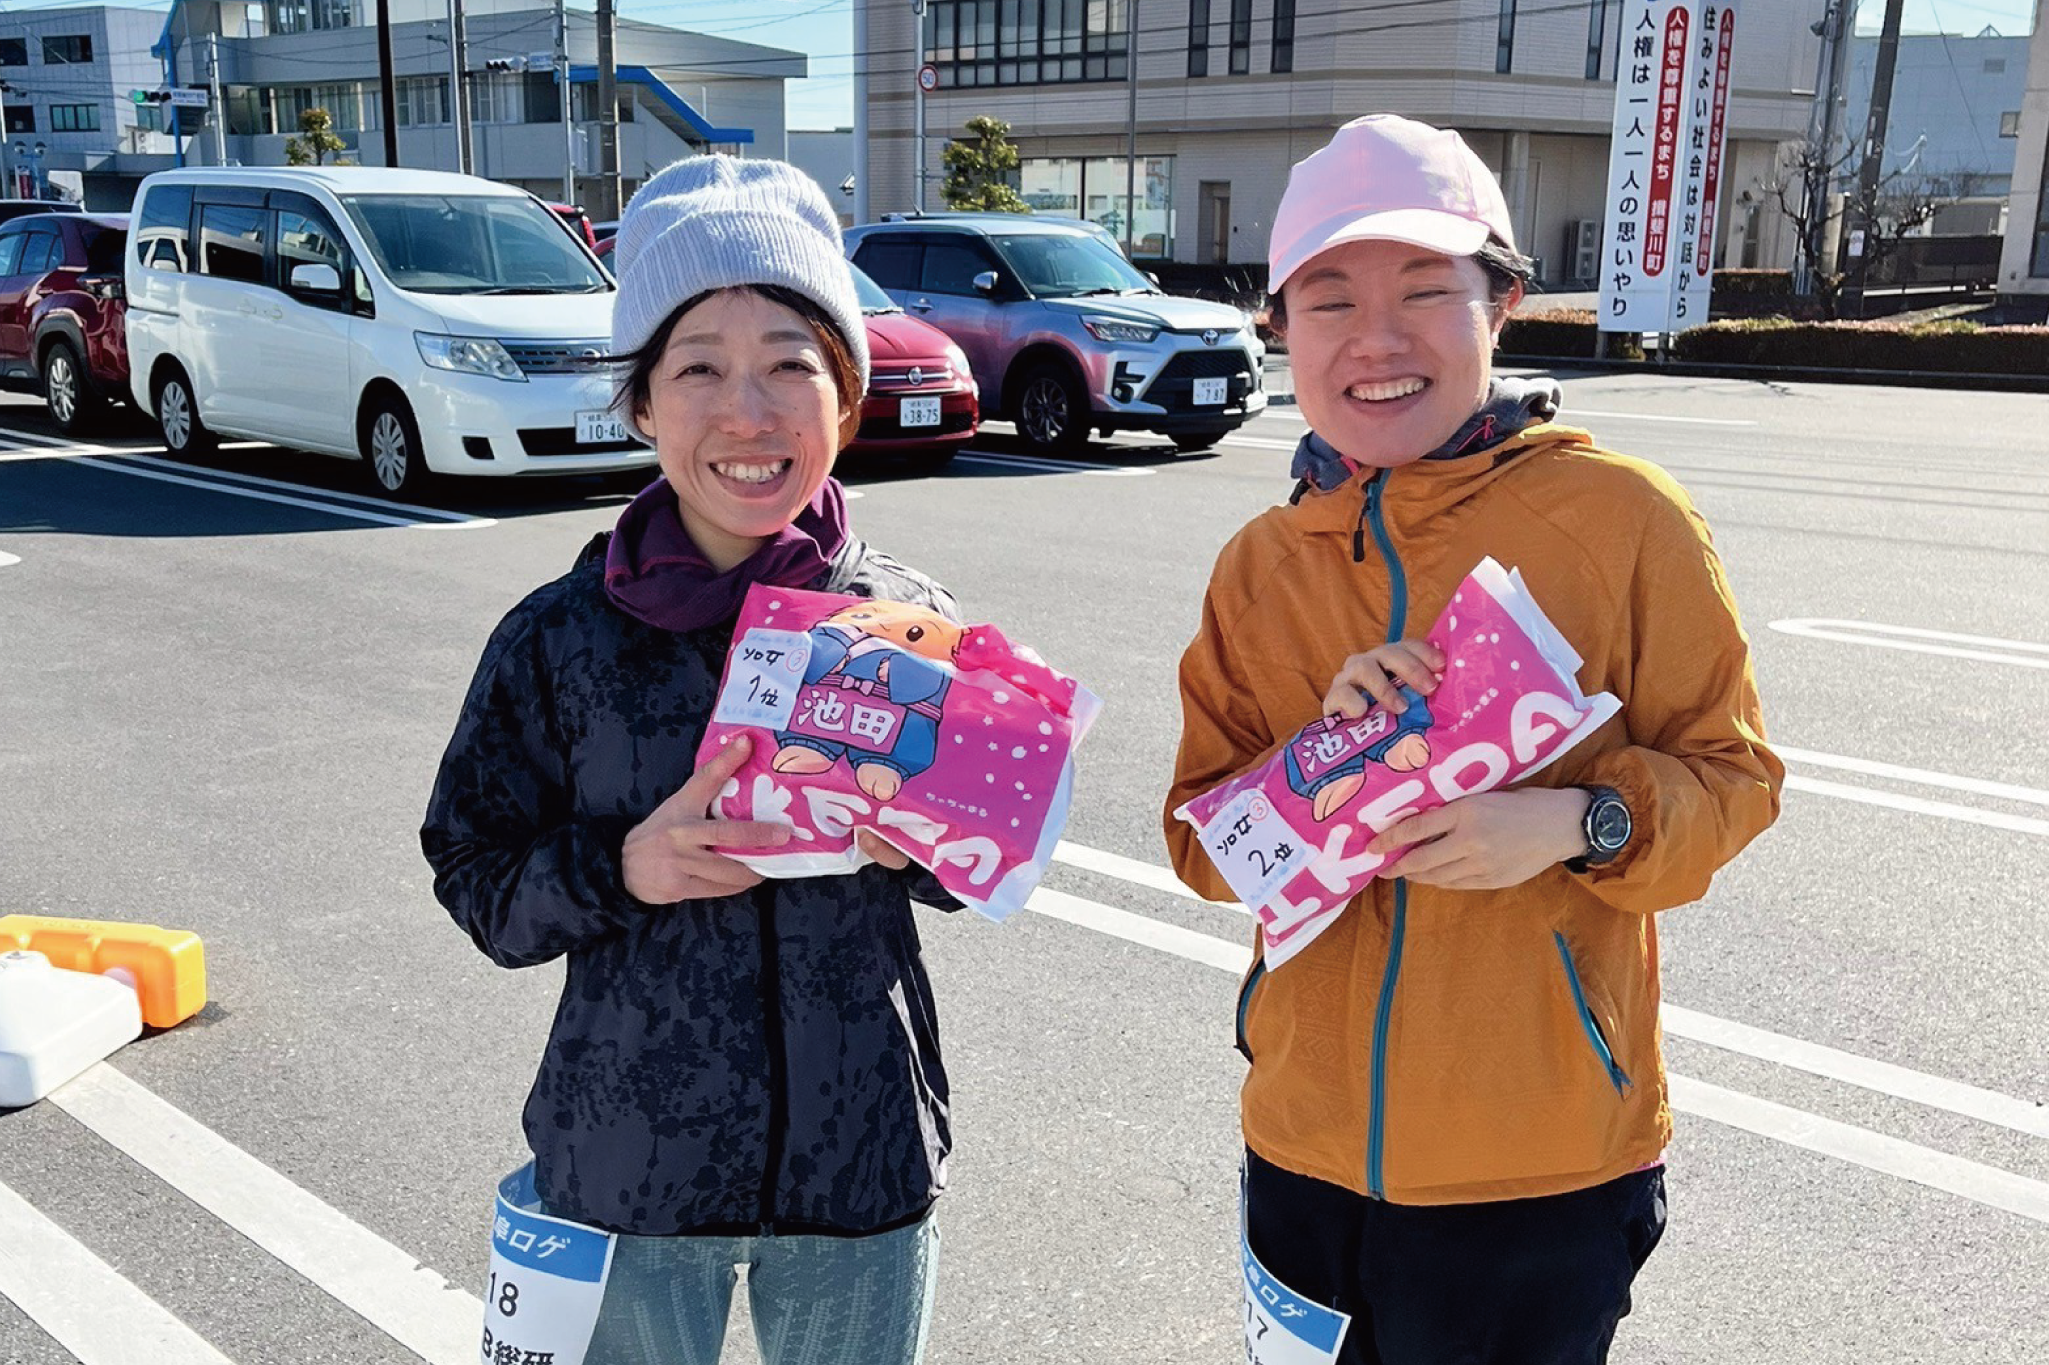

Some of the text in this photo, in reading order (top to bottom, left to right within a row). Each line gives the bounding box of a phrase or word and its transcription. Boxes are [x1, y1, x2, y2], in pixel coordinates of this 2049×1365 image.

[1655, 9, 1686, 180] 人権を尊重するまち
[1612, 8, 1656, 317] 人権は一人一人の思いやり
[1676, 6, 1716, 318] 住みよい社会は対話から
[588, 422, 625, 440] 10-40
[796, 689, 898, 746] 池田
[1301, 710, 1389, 772] 池田
[1247, 842, 1295, 878] 2位
